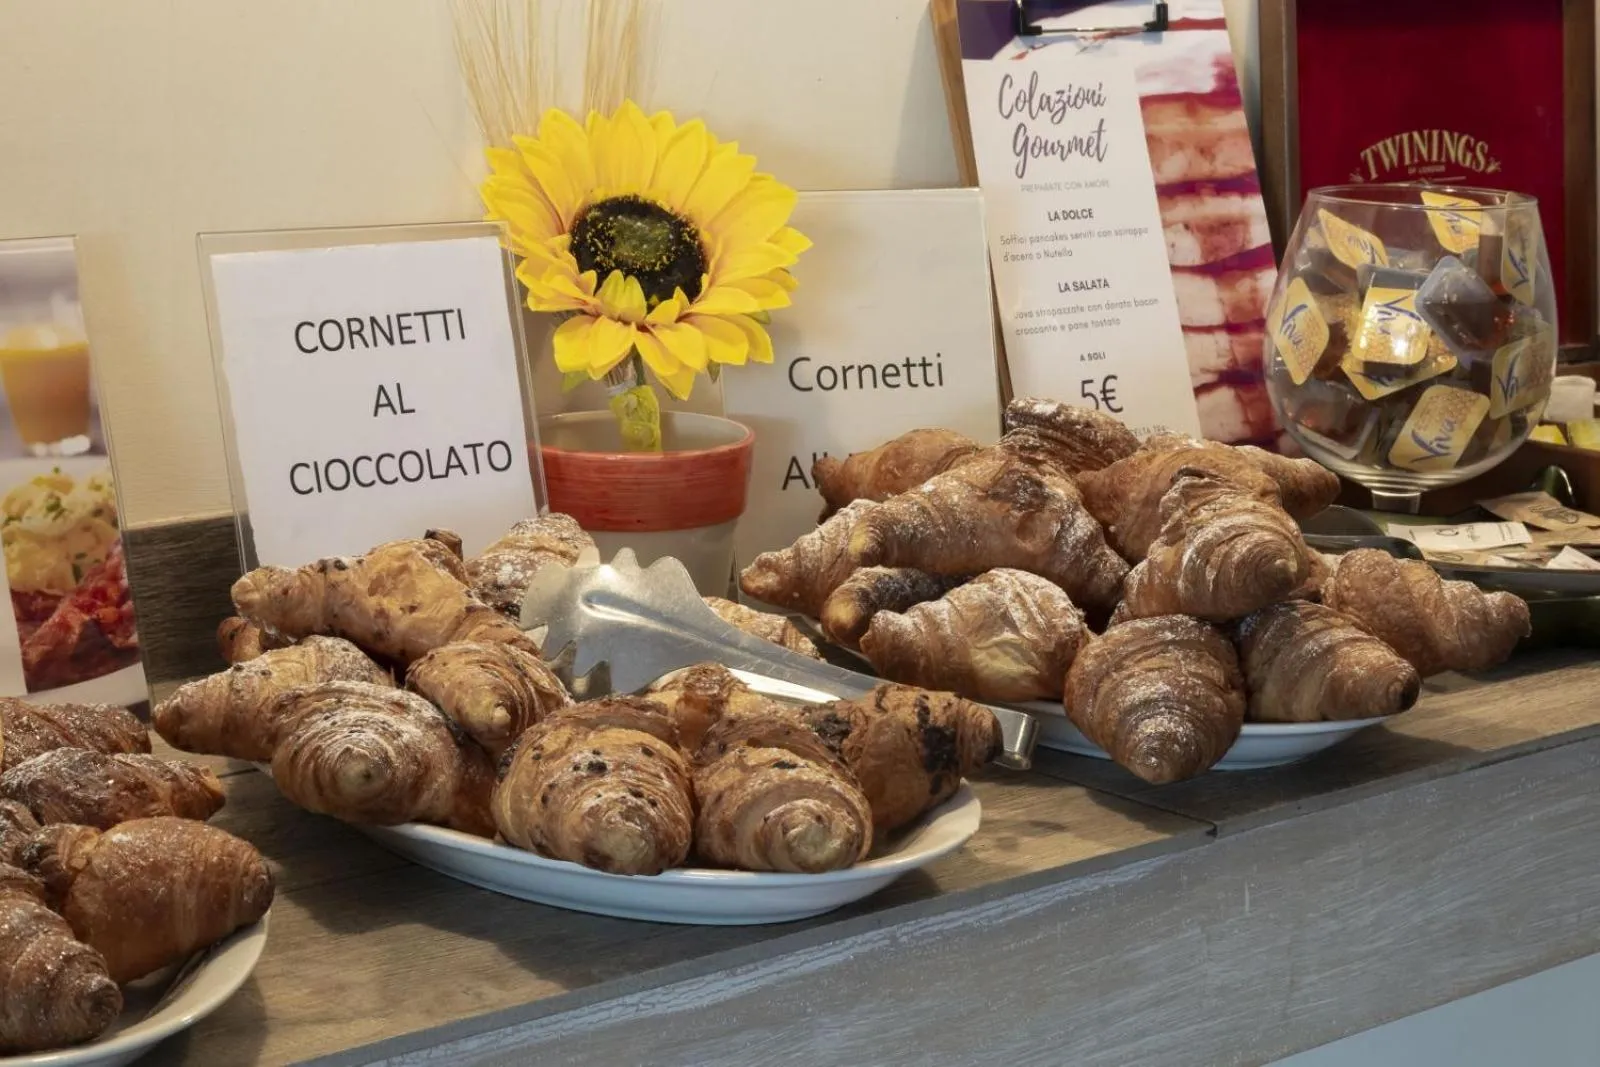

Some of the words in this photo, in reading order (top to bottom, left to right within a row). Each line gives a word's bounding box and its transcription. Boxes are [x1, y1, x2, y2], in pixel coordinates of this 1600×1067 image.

[998, 70, 1107, 125] Colazioni
[1012, 118, 1109, 179] Gourmet
[1360, 129, 1489, 180] TWININGS
[1047, 210, 1062, 222] LA
[1063, 208, 1094, 221] DOLCE
[1029, 231, 1069, 246] pancakes
[1097, 229, 1113, 238] con
[1043, 248, 1074, 259] Nutella
[1058, 282, 1072, 294] LA
[1072, 278, 1111, 292] SALATA
[1087, 303, 1103, 313] con
[294, 307, 466, 354] CORNETTI
[1068, 321, 1089, 335] pane
[788, 352, 944, 392] Cornetti
[1079, 353, 1086, 362] A
[1087, 351, 1107, 362] SOLI
[373, 382, 416, 418] AL
[1080, 374, 1124, 413] 5€
[289, 439, 513, 495] CIOCCOLATO
